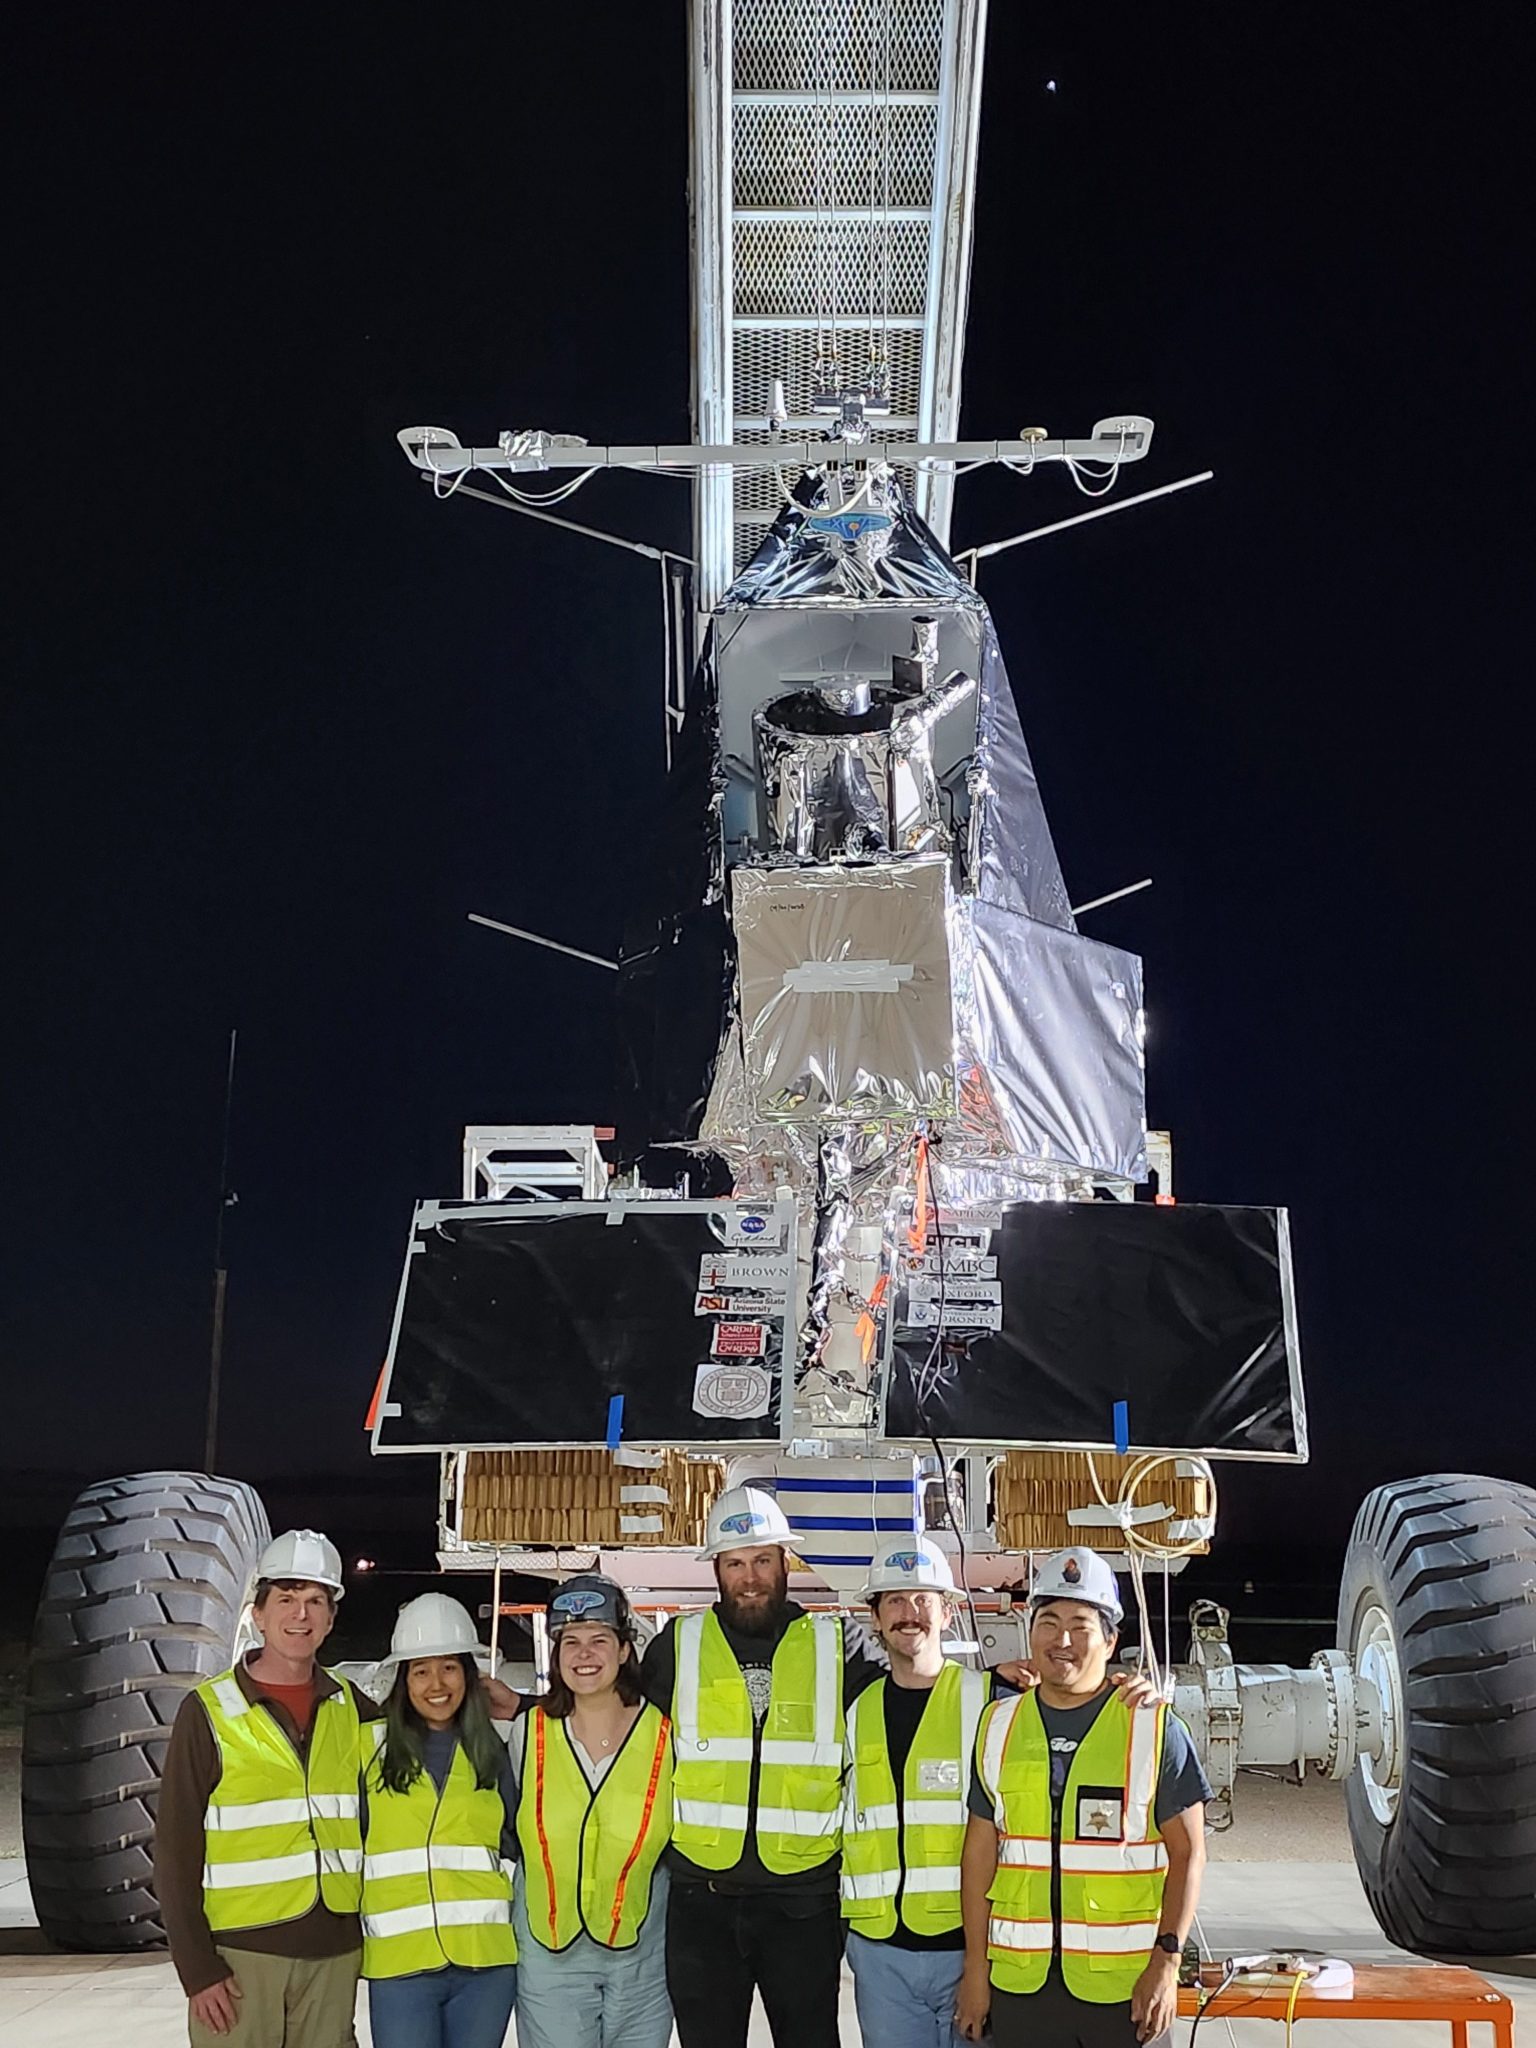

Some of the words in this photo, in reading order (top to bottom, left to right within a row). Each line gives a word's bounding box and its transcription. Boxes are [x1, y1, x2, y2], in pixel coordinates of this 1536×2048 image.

[943, 1208, 1000, 1218] SAPIENZA
[741, 1221, 765, 1230] NASA
[929, 1258, 995, 1273] UMBC
[732, 1267, 789, 1277] BROWN
[697, 1295, 731, 1311] ASU
[764, 1297, 786, 1305] State
[732, 1304, 771, 1313] University
